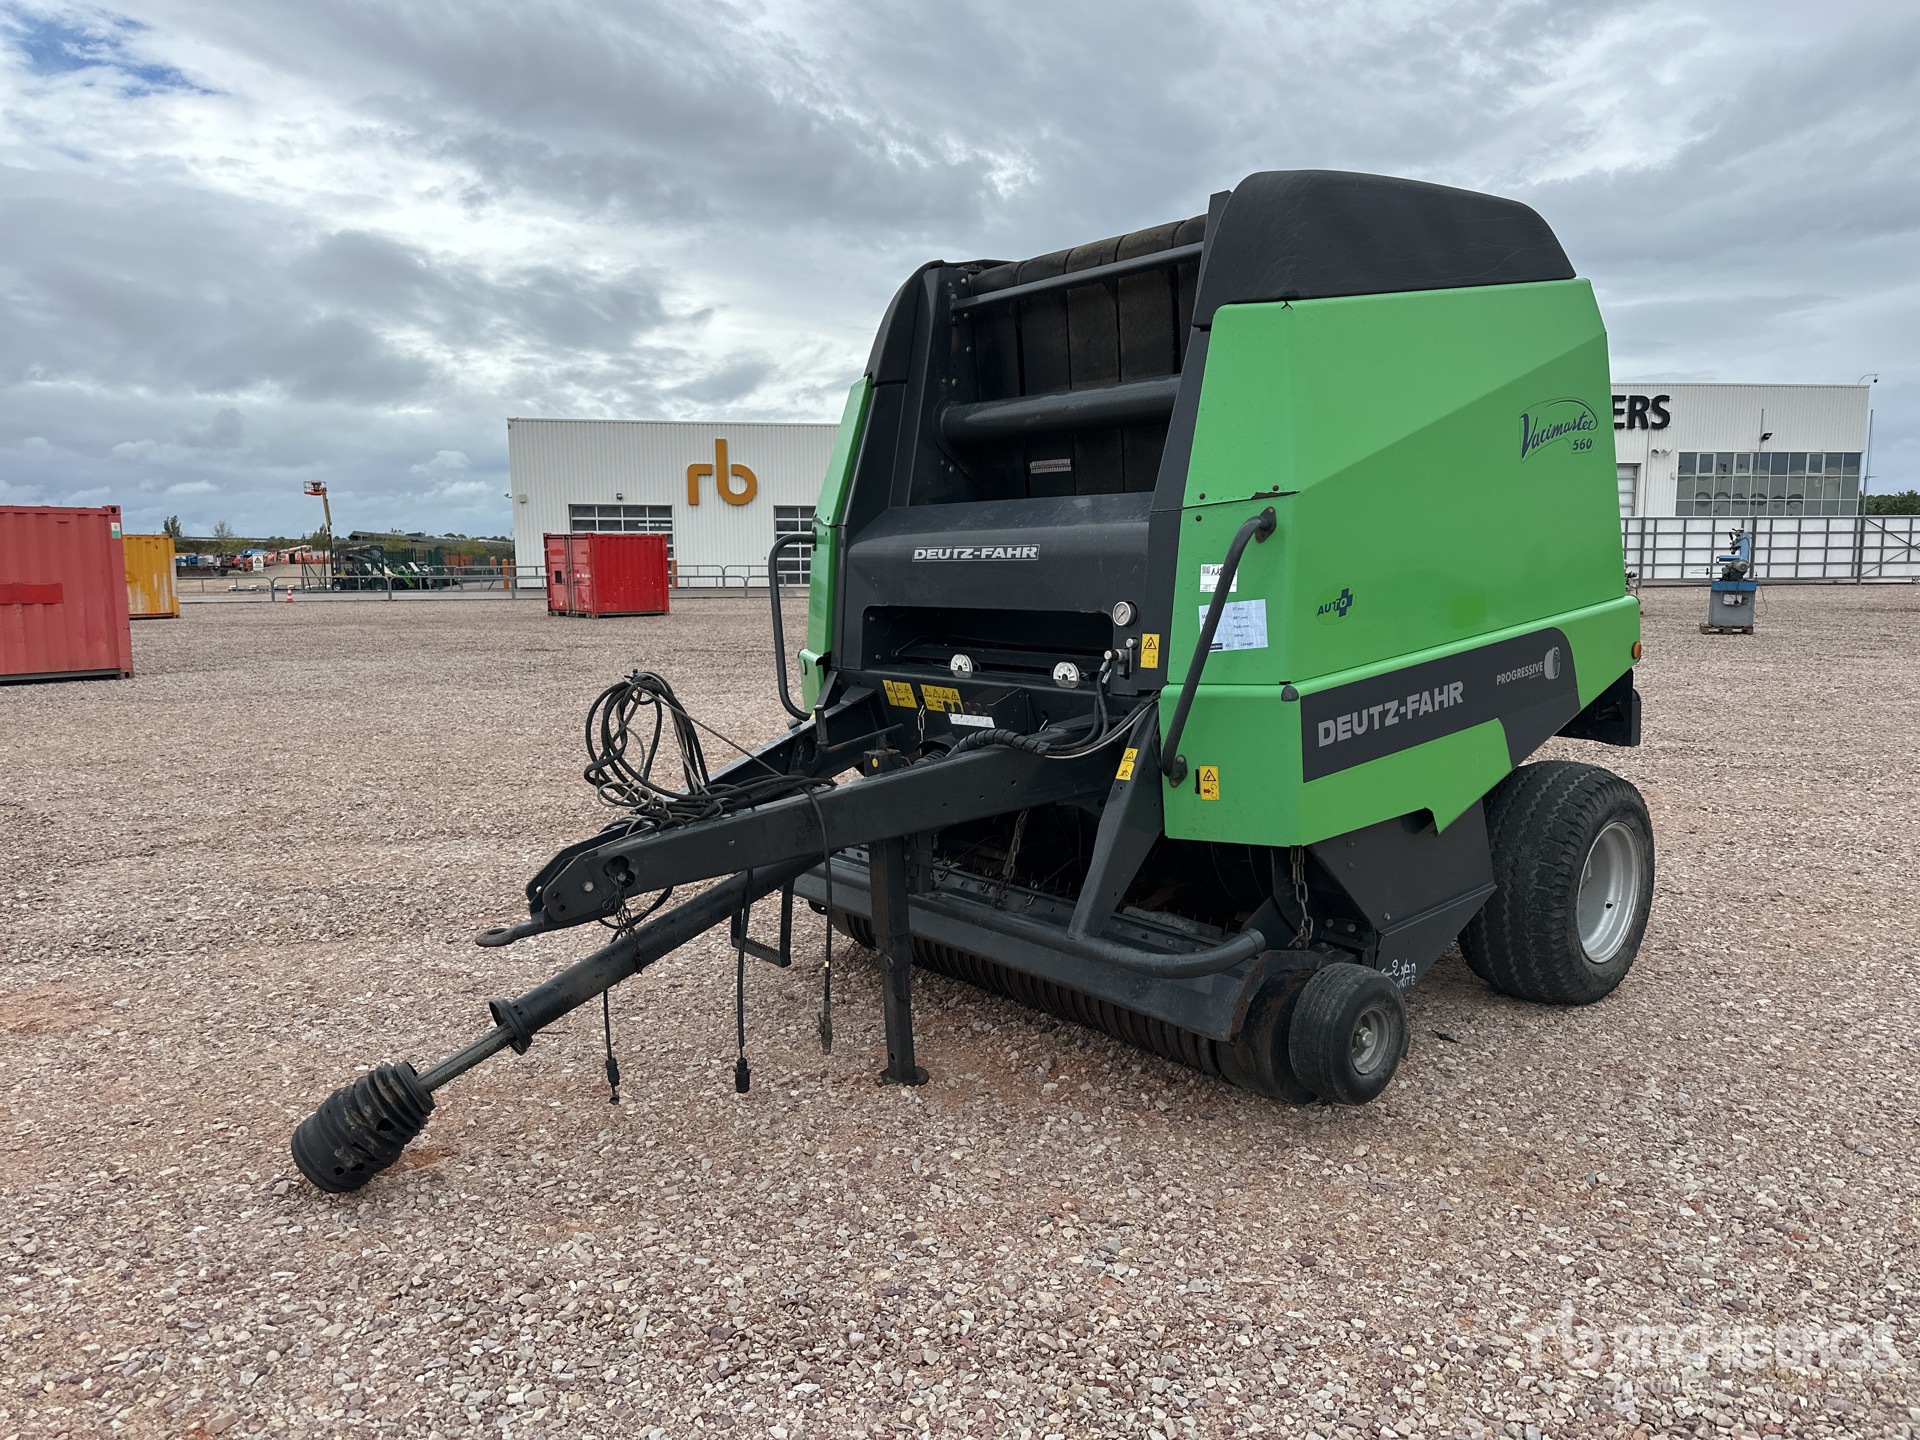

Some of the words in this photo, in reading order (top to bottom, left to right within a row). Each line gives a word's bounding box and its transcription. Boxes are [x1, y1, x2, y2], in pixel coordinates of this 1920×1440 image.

[1572, 438, 1593, 451] 560
[687, 438, 758, 506] rb
[913, 546, 1038, 560] DEUTZ-FAHR
[1496, 661, 1544, 686] PROGRESSIVE
[1317, 681, 1464, 748] DEUTZ-FAHR
